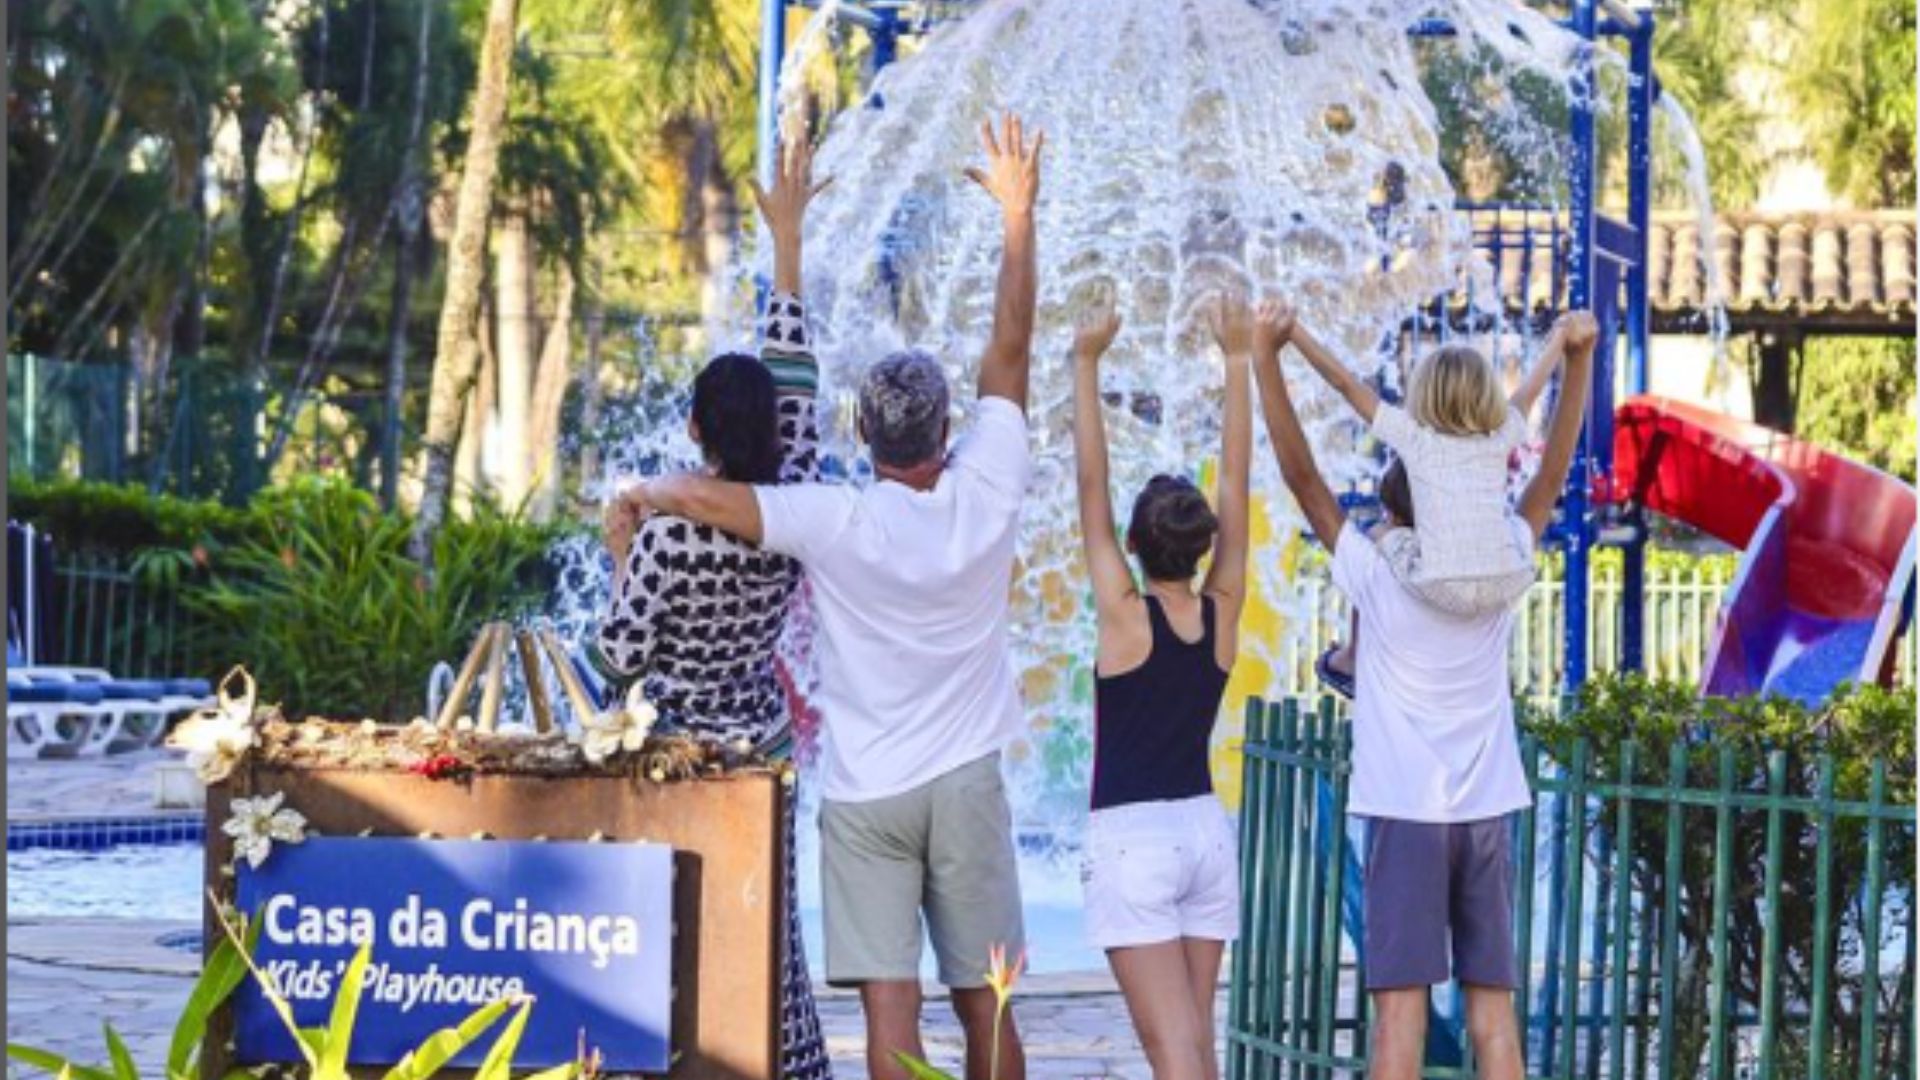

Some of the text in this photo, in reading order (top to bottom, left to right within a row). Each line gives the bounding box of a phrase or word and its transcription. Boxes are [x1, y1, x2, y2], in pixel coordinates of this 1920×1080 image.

[264, 894, 639, 968] Casa da Criança
[262, 959, 525, 1013] Kids' Playhouse
